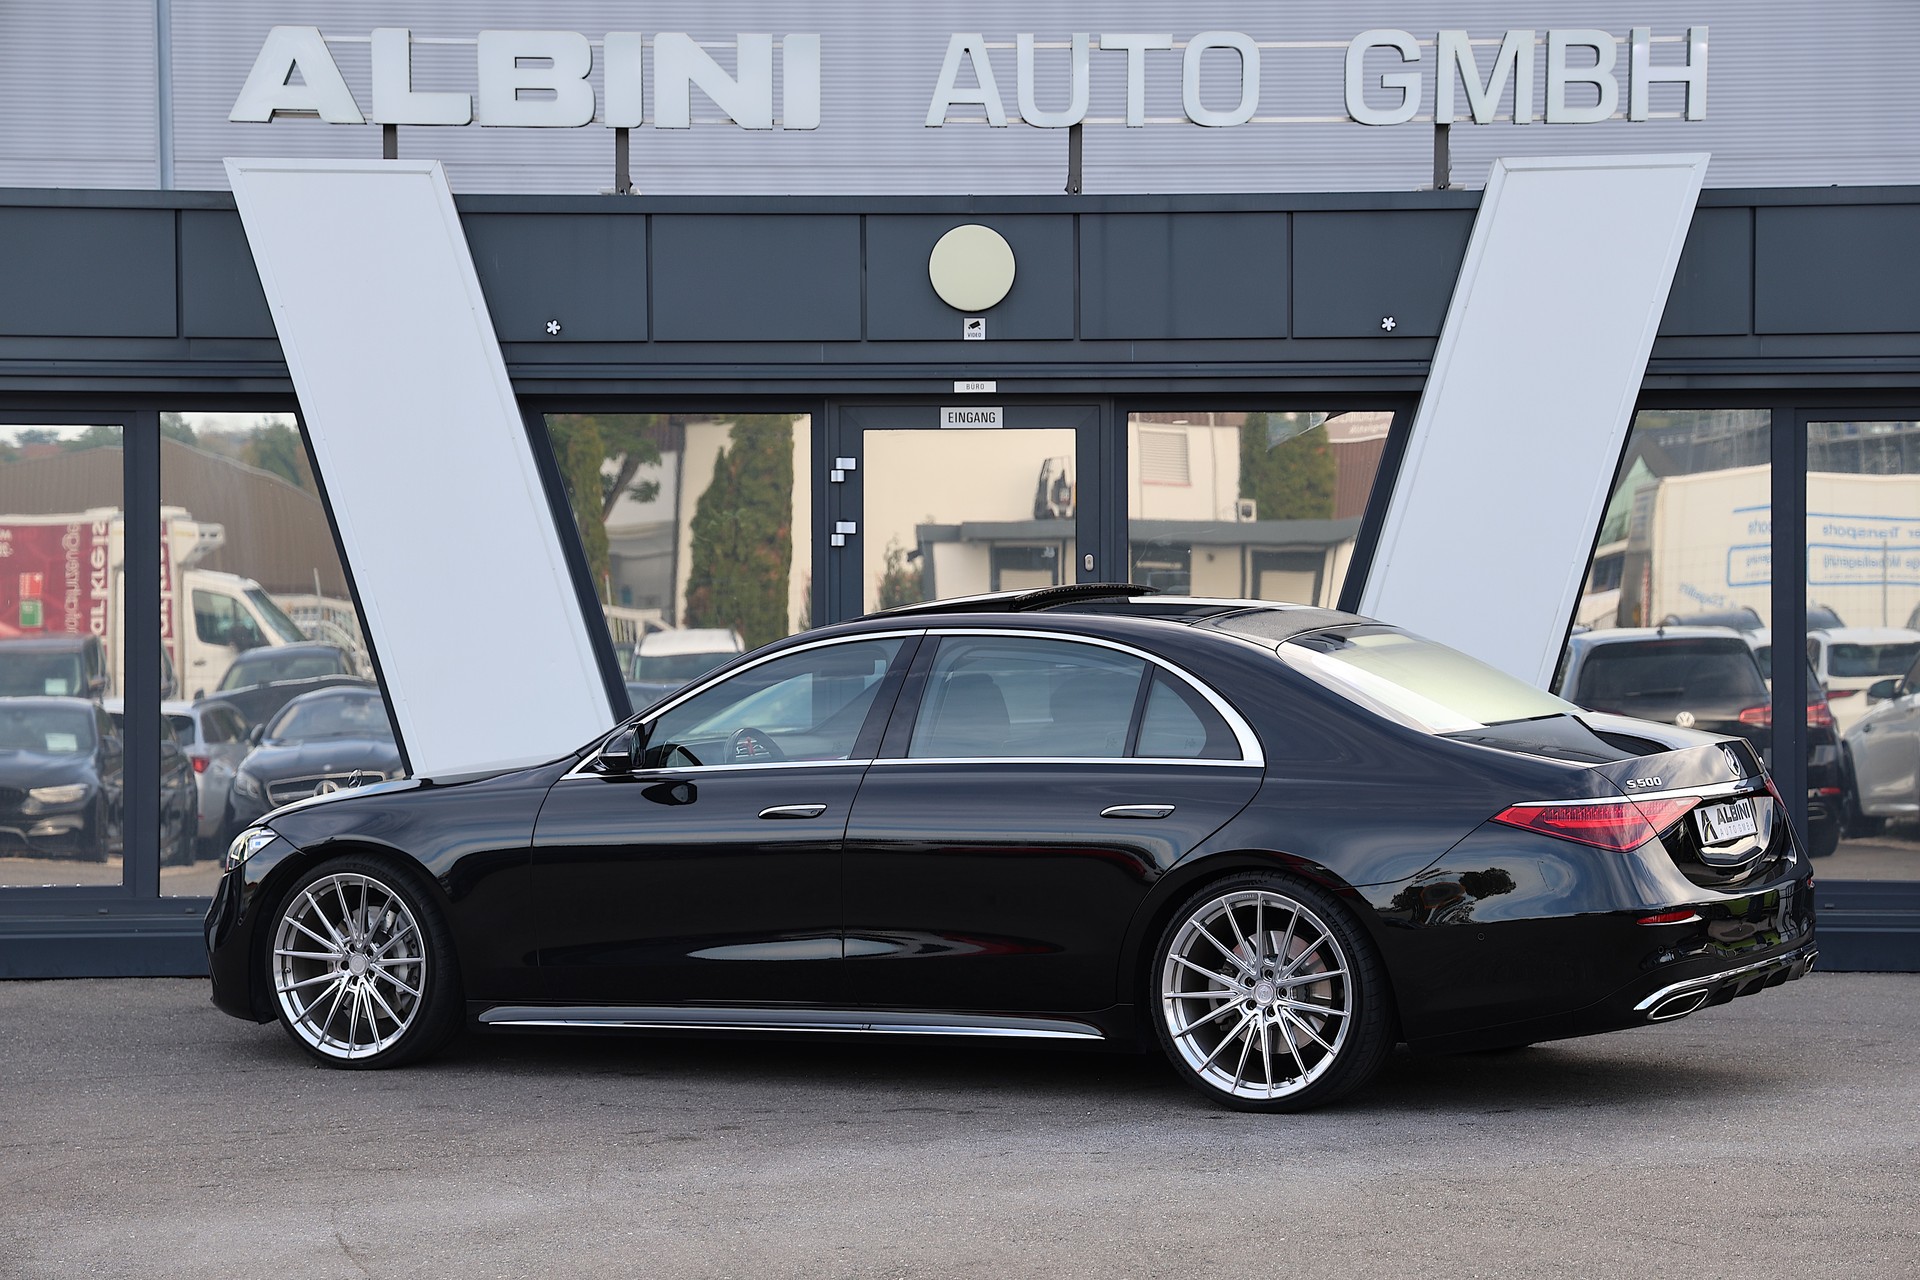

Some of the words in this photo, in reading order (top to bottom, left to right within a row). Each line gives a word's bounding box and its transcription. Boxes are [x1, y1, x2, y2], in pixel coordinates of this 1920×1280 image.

[228, 25, 821, 130] ALBINI
[925, 31, 1261, 128] AUTO
[1344, 26, 1709, 126] GMBH
[948, 412, 996, 424] EINGANG
[1637, 776, 1663, 788] 500
[1717, 802, 1751, 825] ALBINI
